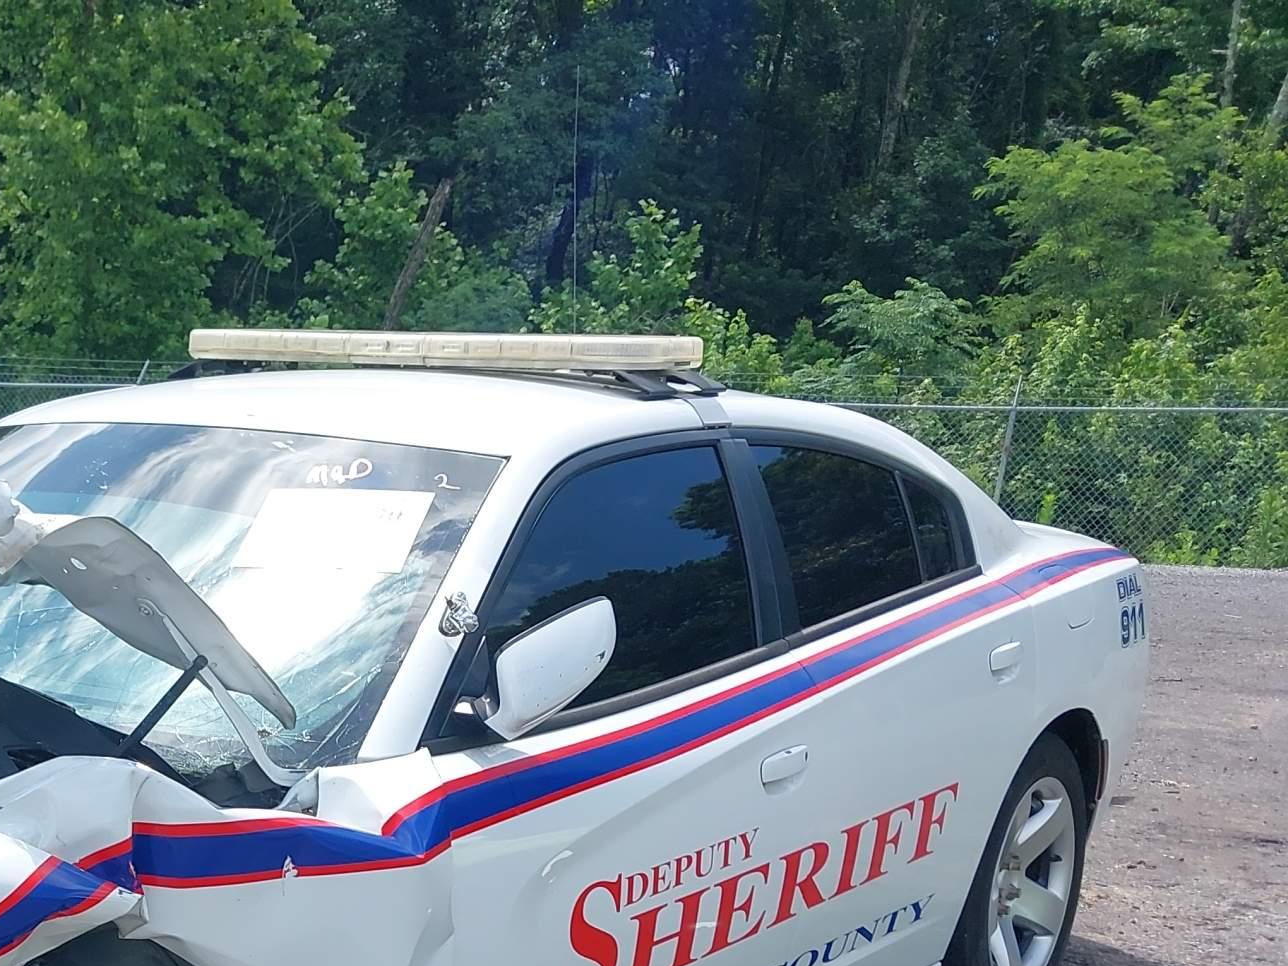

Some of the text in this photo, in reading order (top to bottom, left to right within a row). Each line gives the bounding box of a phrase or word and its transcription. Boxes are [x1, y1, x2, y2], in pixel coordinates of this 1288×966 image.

[434, 473, 462, 490] 2
[1116, 573, 1142, 603] DIAL
[1121, 598, 1146, 649] 911
[624, 827, 760, 907] DEPUTY
